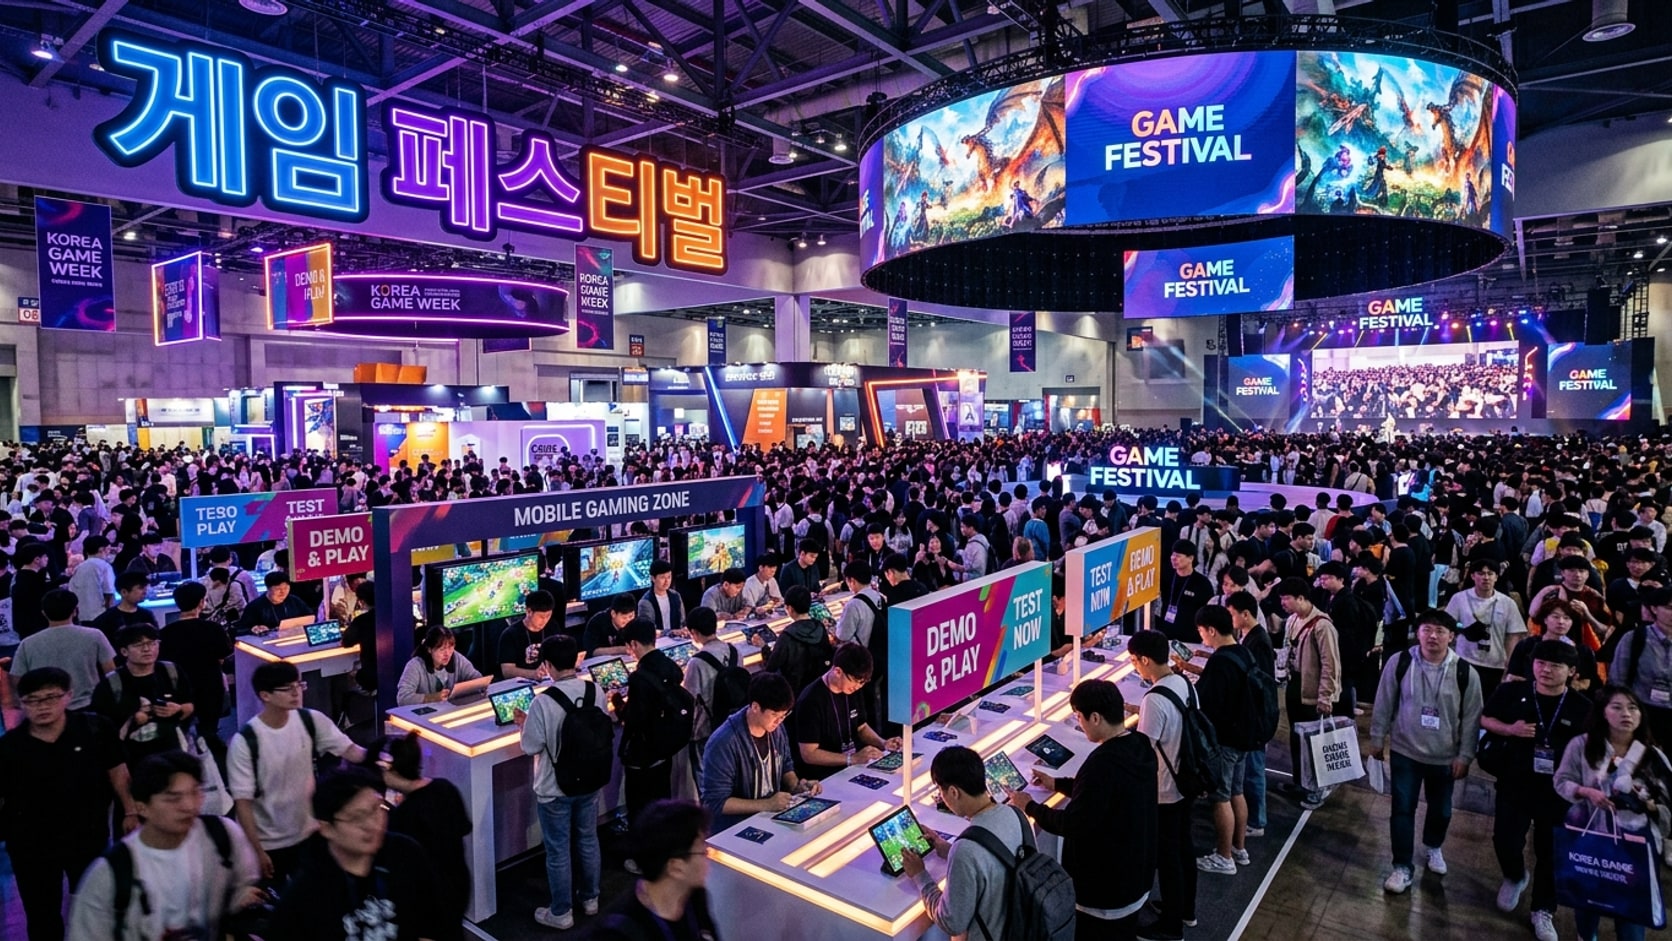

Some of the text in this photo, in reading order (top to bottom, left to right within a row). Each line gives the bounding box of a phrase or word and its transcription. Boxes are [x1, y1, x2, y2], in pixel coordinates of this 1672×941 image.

[1131, 104, 1225, 138] GAME
[110, 40, 724, 269] 게임 페스티벌
[1105, 135, 1252, 171] FESTIVAL
[47, 231, 103, 250] KOREA
[48, 246, 102, 264] GAME
[49, 261, 103, 279] WEEK
[1178, 259, 1234, 280] GAME
[371, 284, 421, 297] KOREA
[1163, 277, 1250, 298] FESTIVAL
[370, 297, 461, 311] GAME WEEK
[1367, 297, 1423, 315] GAME
[1359, 313, 1434, 329] FESTIVAL
[1243, 377, 1272, 386] GAME
[1569, 368, 1608, 379] GAME
[1559, 379, 1618, 390] FESTIVAL
[1109, 445, 1179, 467] GAME
[1090, 466, 1201, 490] FESTIVAL
[286, 498, 325, 514] TEST
[514, 490, 690, 527] MOBILE GAMING ZONE
[197, 520, 236, 536] PLAY
[309, 526, 364, 547] DEMO
[307, 545, 369, 567] & PLAY
[1090, 561, 1112, 588] TEST
[1013, 588, 1043, 621] TEST
[927, 612, 976, 657] DEMO
[1013, 615, 1042, 650] NOW
[924, 643, 981, 693] & PLAY
